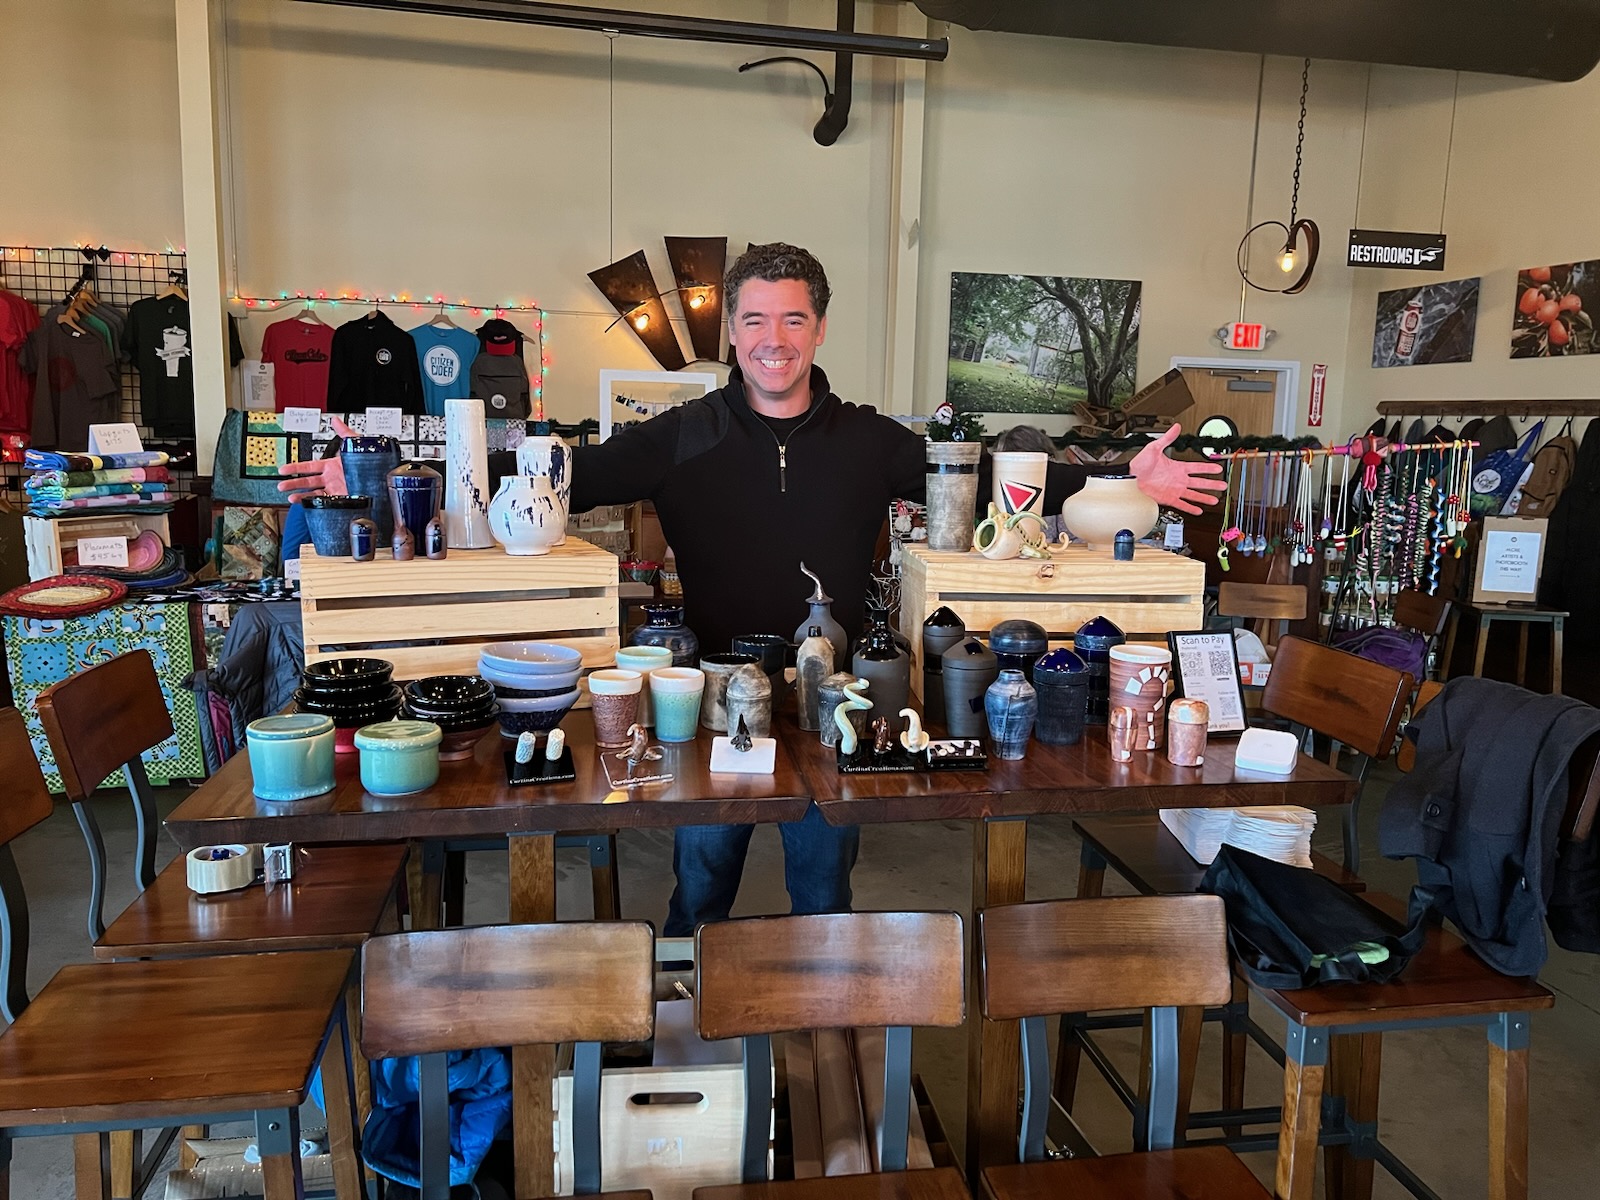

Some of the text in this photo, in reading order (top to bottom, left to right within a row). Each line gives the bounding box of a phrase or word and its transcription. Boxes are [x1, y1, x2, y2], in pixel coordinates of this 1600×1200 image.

[1350, 244, 1413, 265] RESTROOMS
[1233, 323, 1262, 348] EXIT
[430, 356, 454, 367] CITIZEN
[431, 364, 454, 378] CIDER
[1181, 635, 1225, 645] Scan to Pay
